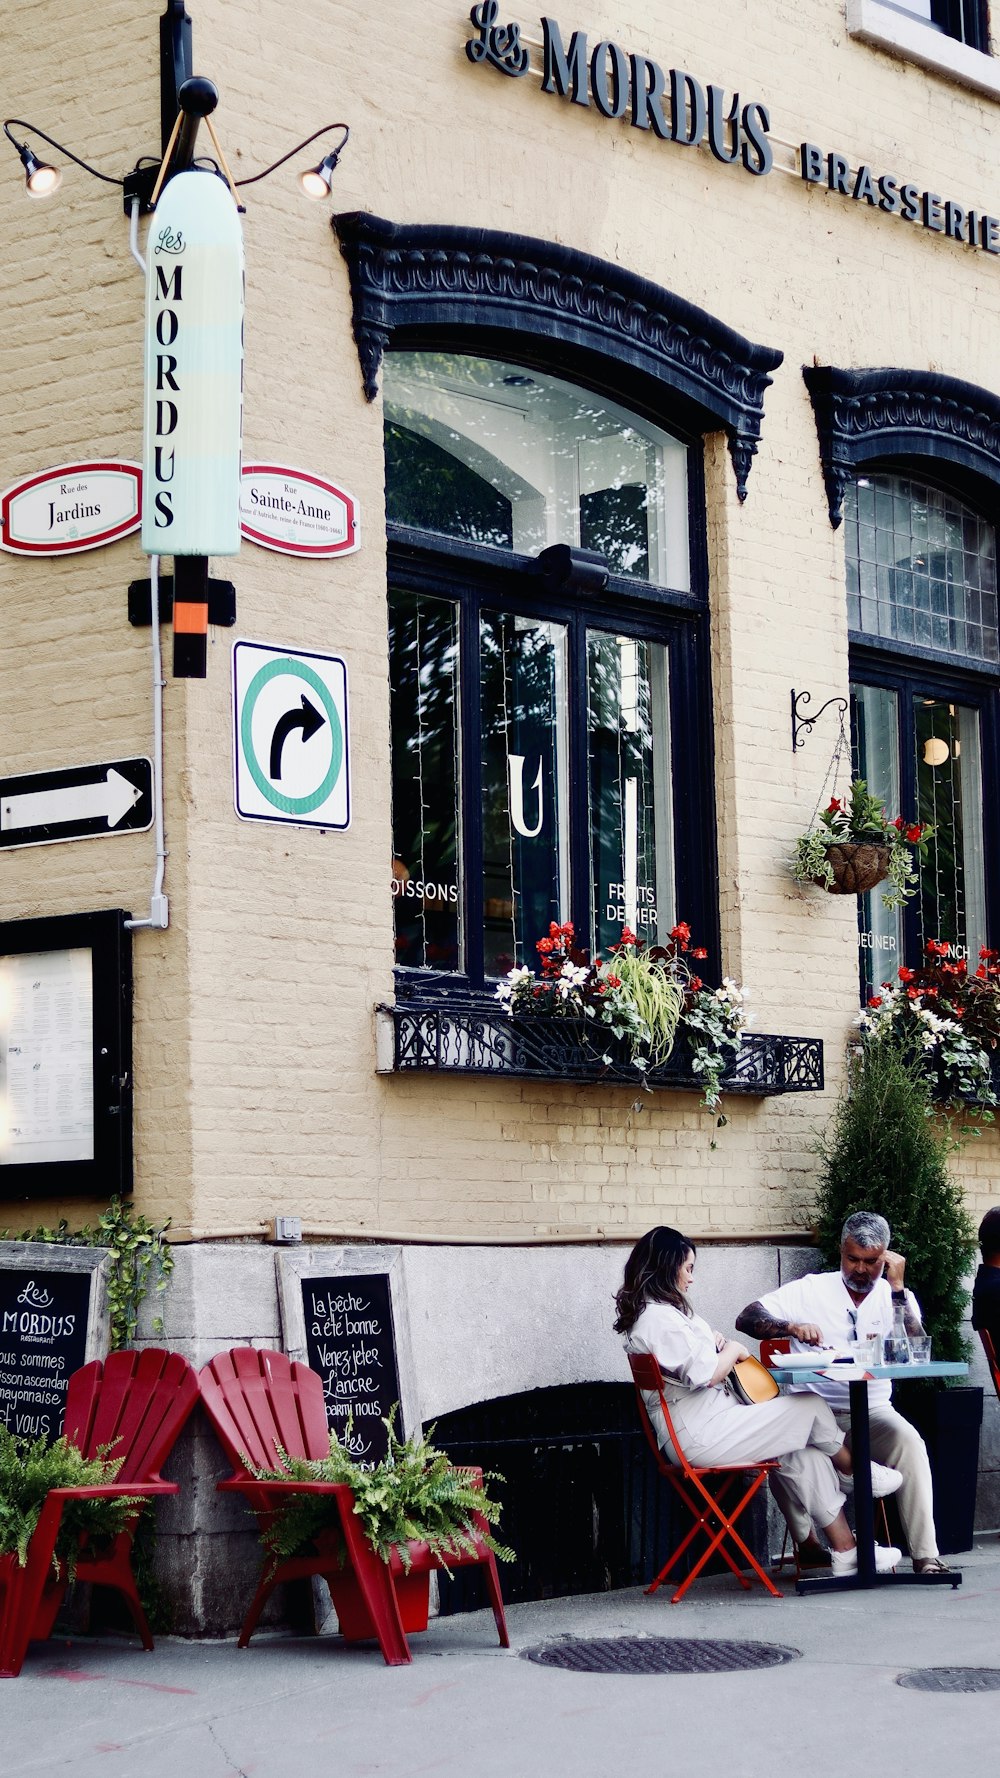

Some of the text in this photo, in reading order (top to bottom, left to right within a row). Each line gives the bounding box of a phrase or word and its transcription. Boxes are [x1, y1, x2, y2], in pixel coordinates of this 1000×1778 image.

[465, 0, 1000, 254] Les MORDUS BRASSERIE
[154, 226, 186, 254] Les
[154, 265, 184, 528] MORDUS
[60, 483, 88, 494] Rue des
[284, 484, 297, 494] Rue
[48, 501, 101, 530] Jardins
[250, 488, 331, 521] Sainte-Anne
[508, 754, 544, 838] U
[608, 883, 655, 903] FRITS
[16, 1280, 54, 1308] Les
[311, 1292, 327, 1317] La
[1, 1311, 76, 1337] MORDUS
[312, 1313, 382, 1337] a été bonne
[20, 1354, 65, 1370] sommes
[316, 1343, 351, 1376] Venez
[355, 1400, 382, 1416] nous
